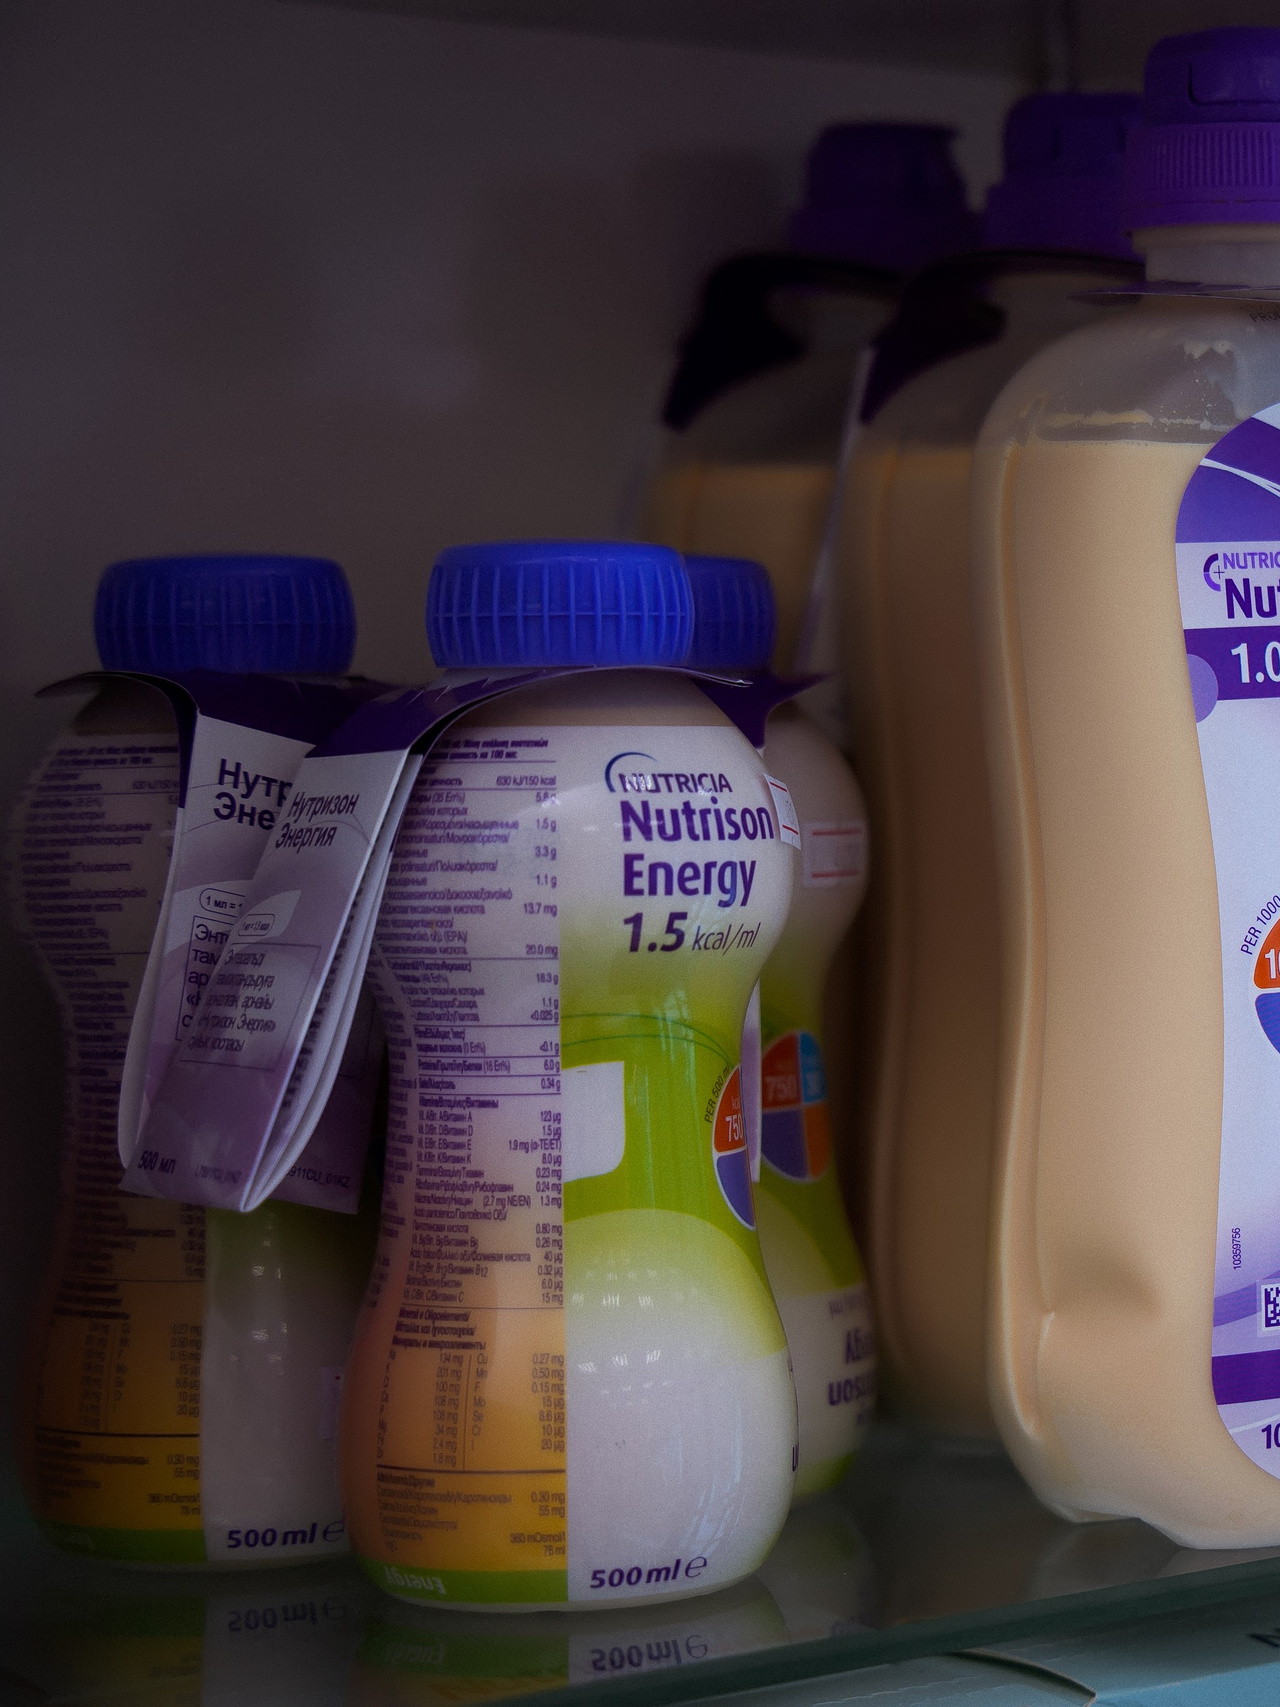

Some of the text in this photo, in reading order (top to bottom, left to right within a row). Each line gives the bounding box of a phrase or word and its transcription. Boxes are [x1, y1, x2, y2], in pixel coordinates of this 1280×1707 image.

[218, 758, 293, 807] Нутр
[618, 773, 733, 793] NUTRICIA
[214, 792, 275, 831] Эне
[288, 792, 360, 823] Нутризон
[620, 796, 774, 842] Nutrison
[275, 823, 338, 854] Энергия
[623, 853, 756, 908] Energy
[623, 912, 761, 955] 1.5 kcal/ml
[1240, 926, 1261, 955] PER
[704, 1101, 718, 1124] PER
[712, 1076, 724, 1099] 500
[138, 1150, 158, 1170] 500
[158, 1156, 176, 1174] мл
[1231, 1227, 1242, 1271] 10359756
[227, 1528, 277, 1548] 500
[281, 1522, 318, 1546] ml
[384, 1566, 447, 1595] Energy
[590, 1566, 642, 1589] 500
[646, 1559, 681, 1584] ml
